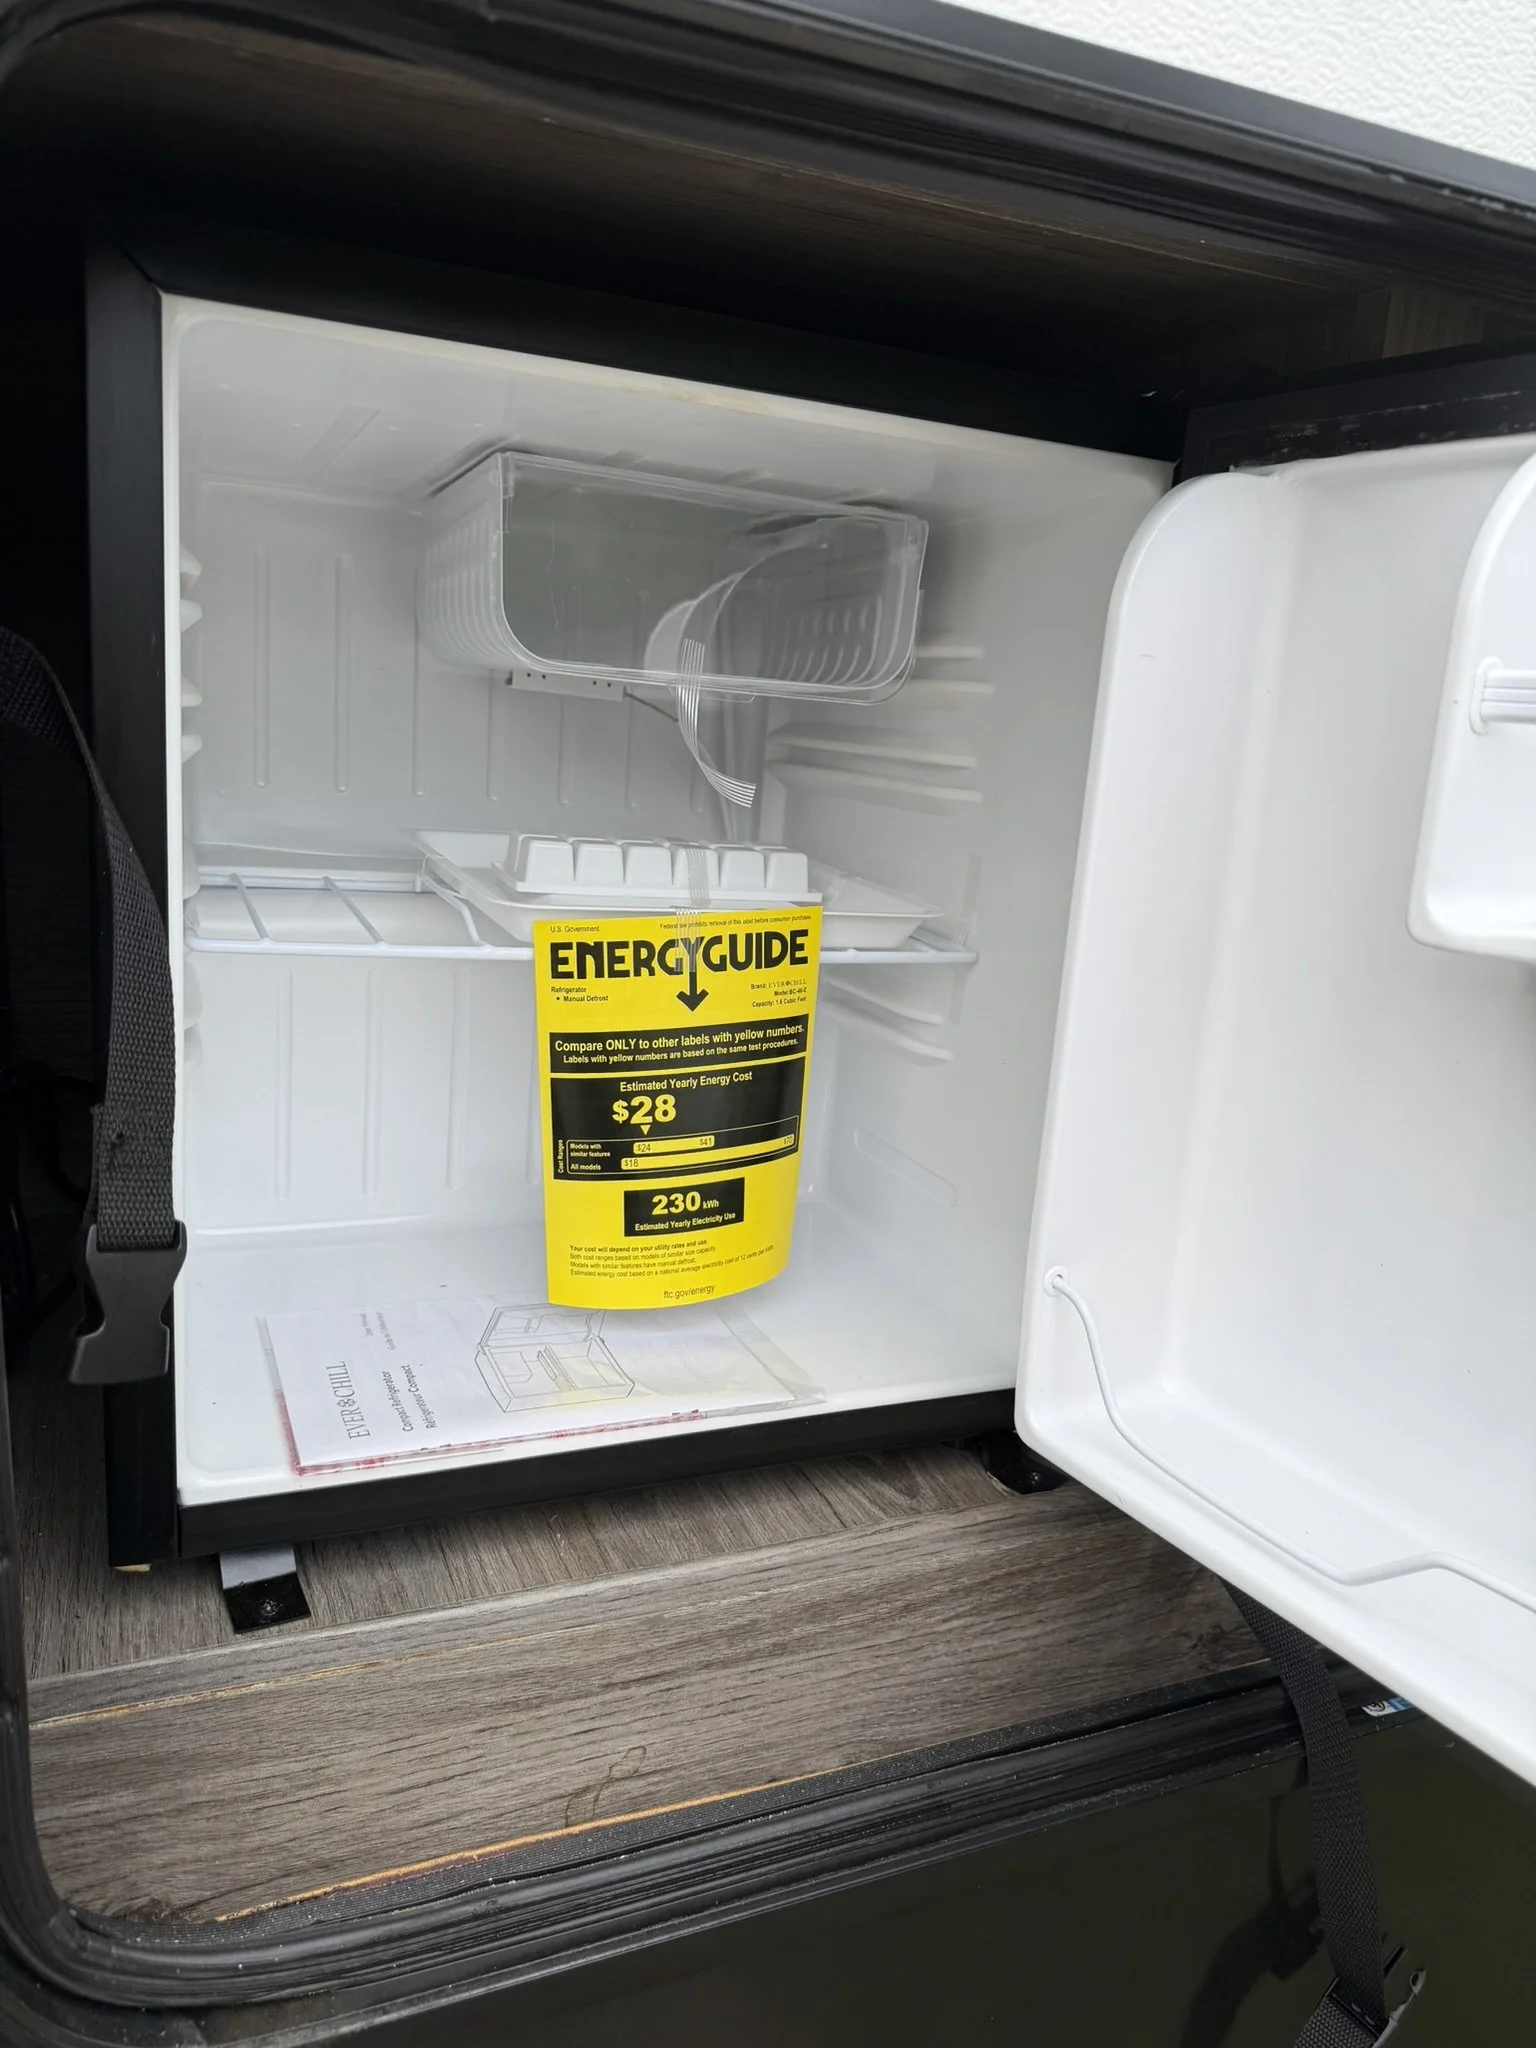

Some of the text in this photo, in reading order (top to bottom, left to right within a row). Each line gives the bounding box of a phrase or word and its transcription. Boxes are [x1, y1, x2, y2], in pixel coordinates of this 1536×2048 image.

[708, 919, 728, 927] removal
[754, 916, 769, 924] before
[549, 928, 809, 980] ENERGYGUIDE
[551, 986, 588, 995] Refrigerator
[752, 1000, 774, 1008] Capacity:
[555, 1023, 805, 1054] Compare ONLY to other labels with yellow numbers.
[563, 1038, 799, 1065] Labels with yellow numbers are based on the same test procedures.
[620, 1071, 753, 1092] Estimated Yearly Energy Cost
[612, 1093, 677, 1125] $28
[557, 1139, 565, 1160] Ranges
[637, 1137, 713, 1153] $24 $41
[580, 1163, 602, 1171] models
[624, 1158, 639, 1168] $18
[652, 1191, 720, 1216] 230 kWh
[634, 1212, 736, 1232] Estimated Yearly Electricity Use
[654, 1243, 670, 1251] utility
[686, 1240, 696, 1248] and
[641, 1252, 660, 1260] models
[597, 1271, 616, 1279] energy
[659, 1267, 680, 1275] national
[680, 1264, 701, 1273] average
[602, 1262, 620, 1270] similar
[663, 1284, 716, 1300] ftc.gov/energy
[400, 1364, 420, 1393] Compact
[381, 1370, 402, 1407] Refrigerator
[394, 1406, 415, 1432] Compact
